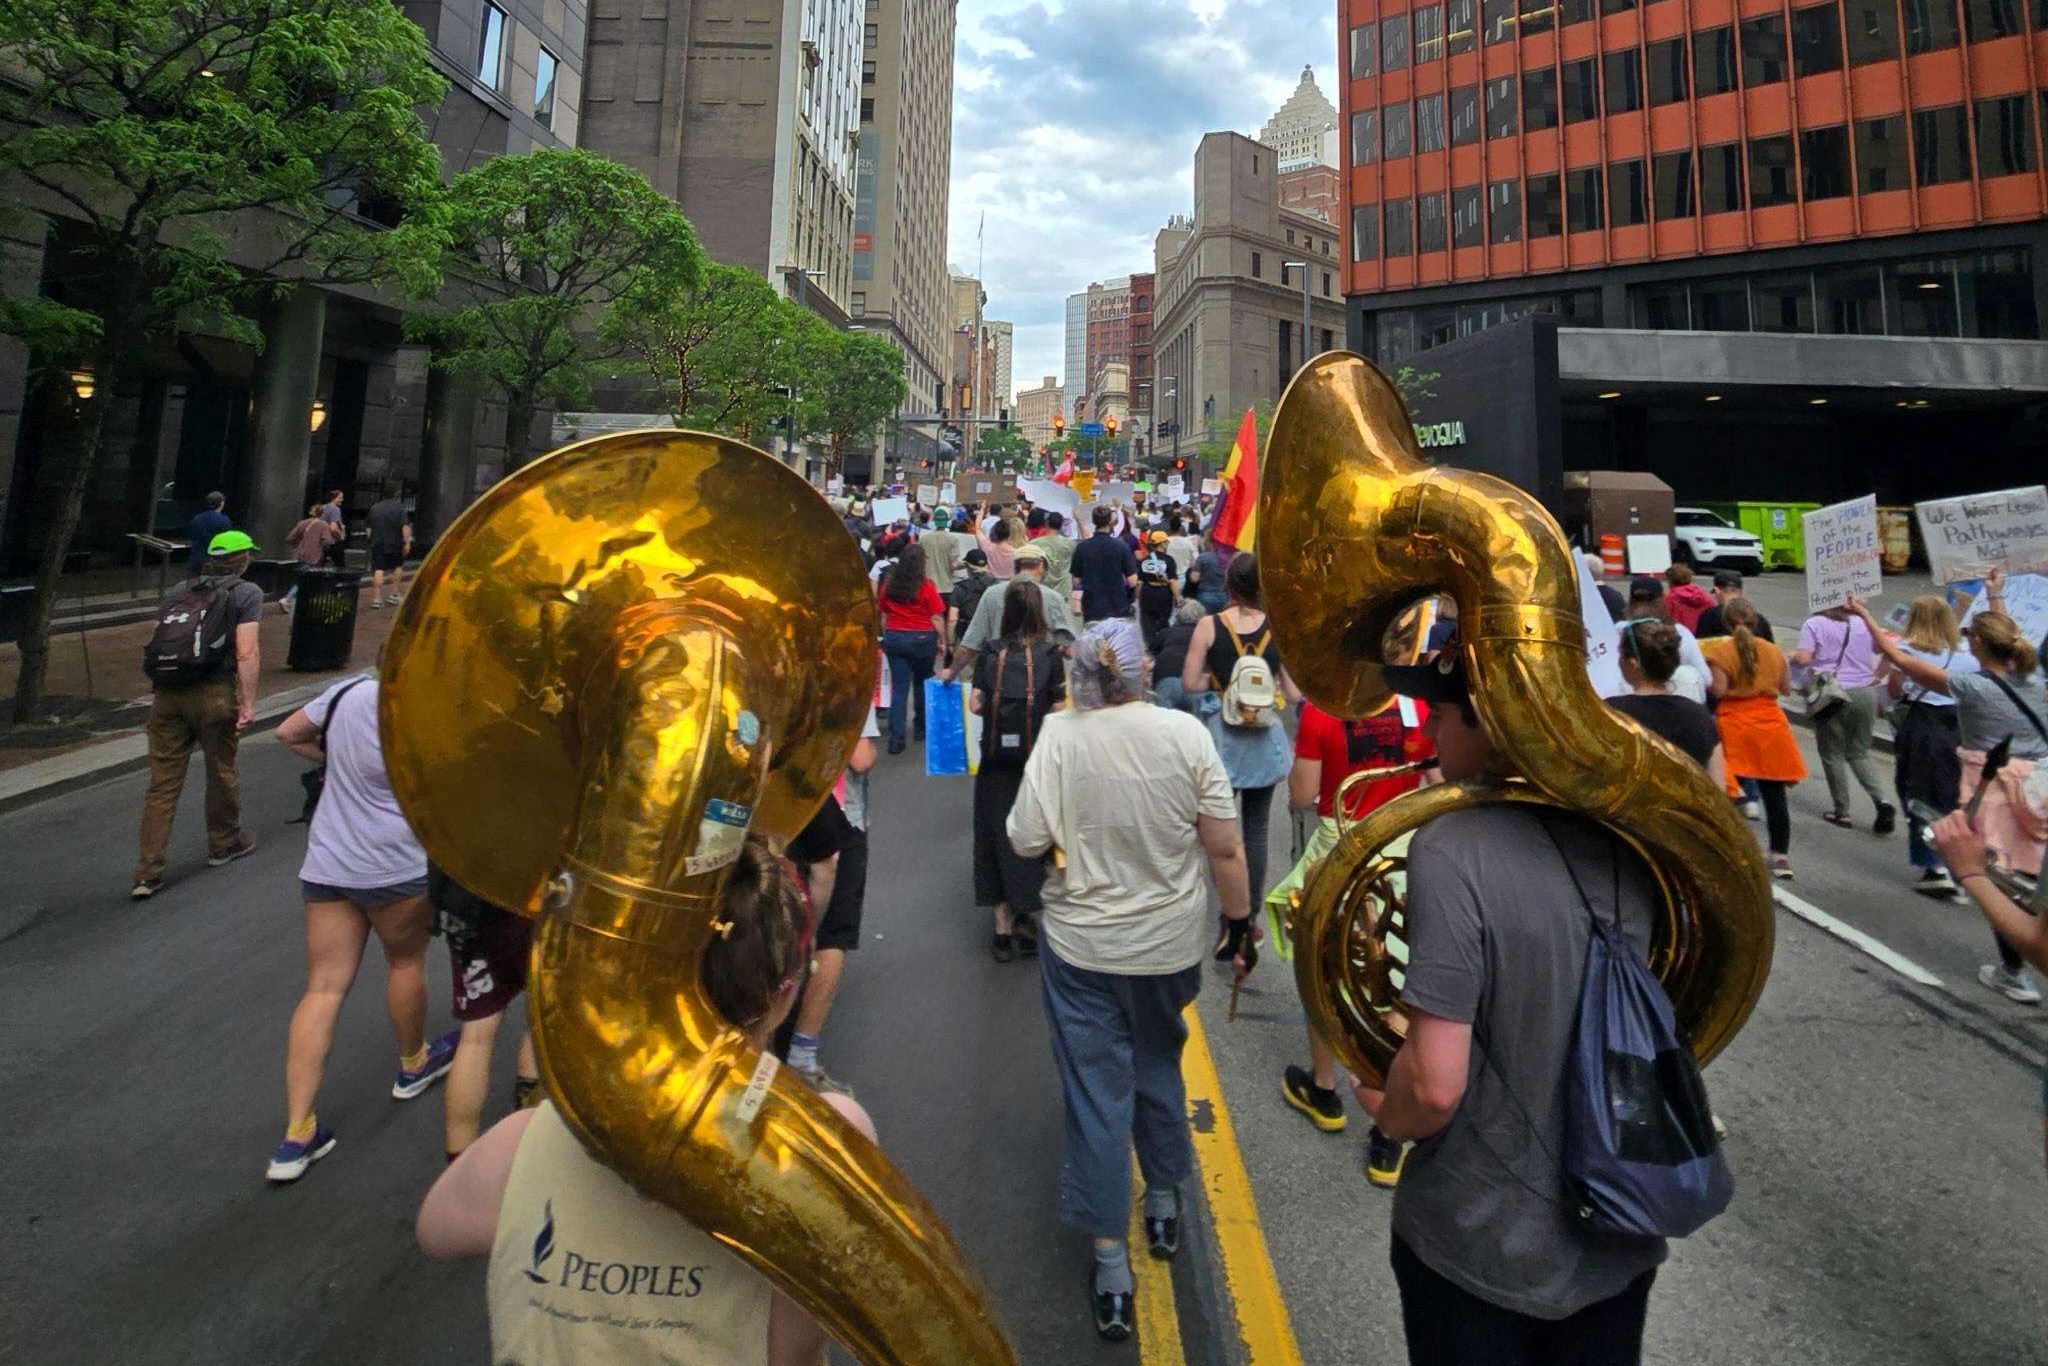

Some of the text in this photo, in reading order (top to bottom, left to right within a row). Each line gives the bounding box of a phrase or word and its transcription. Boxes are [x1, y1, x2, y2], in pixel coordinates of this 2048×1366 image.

[1924, 506, 1957, 525] We
[1823, 529, 1837, 543] of
[1815, 532, 1874, 561] PEOPLE
[1977, 541, 2008, 558] Not
[560, 1250, 704, 1298] PEOPLES
